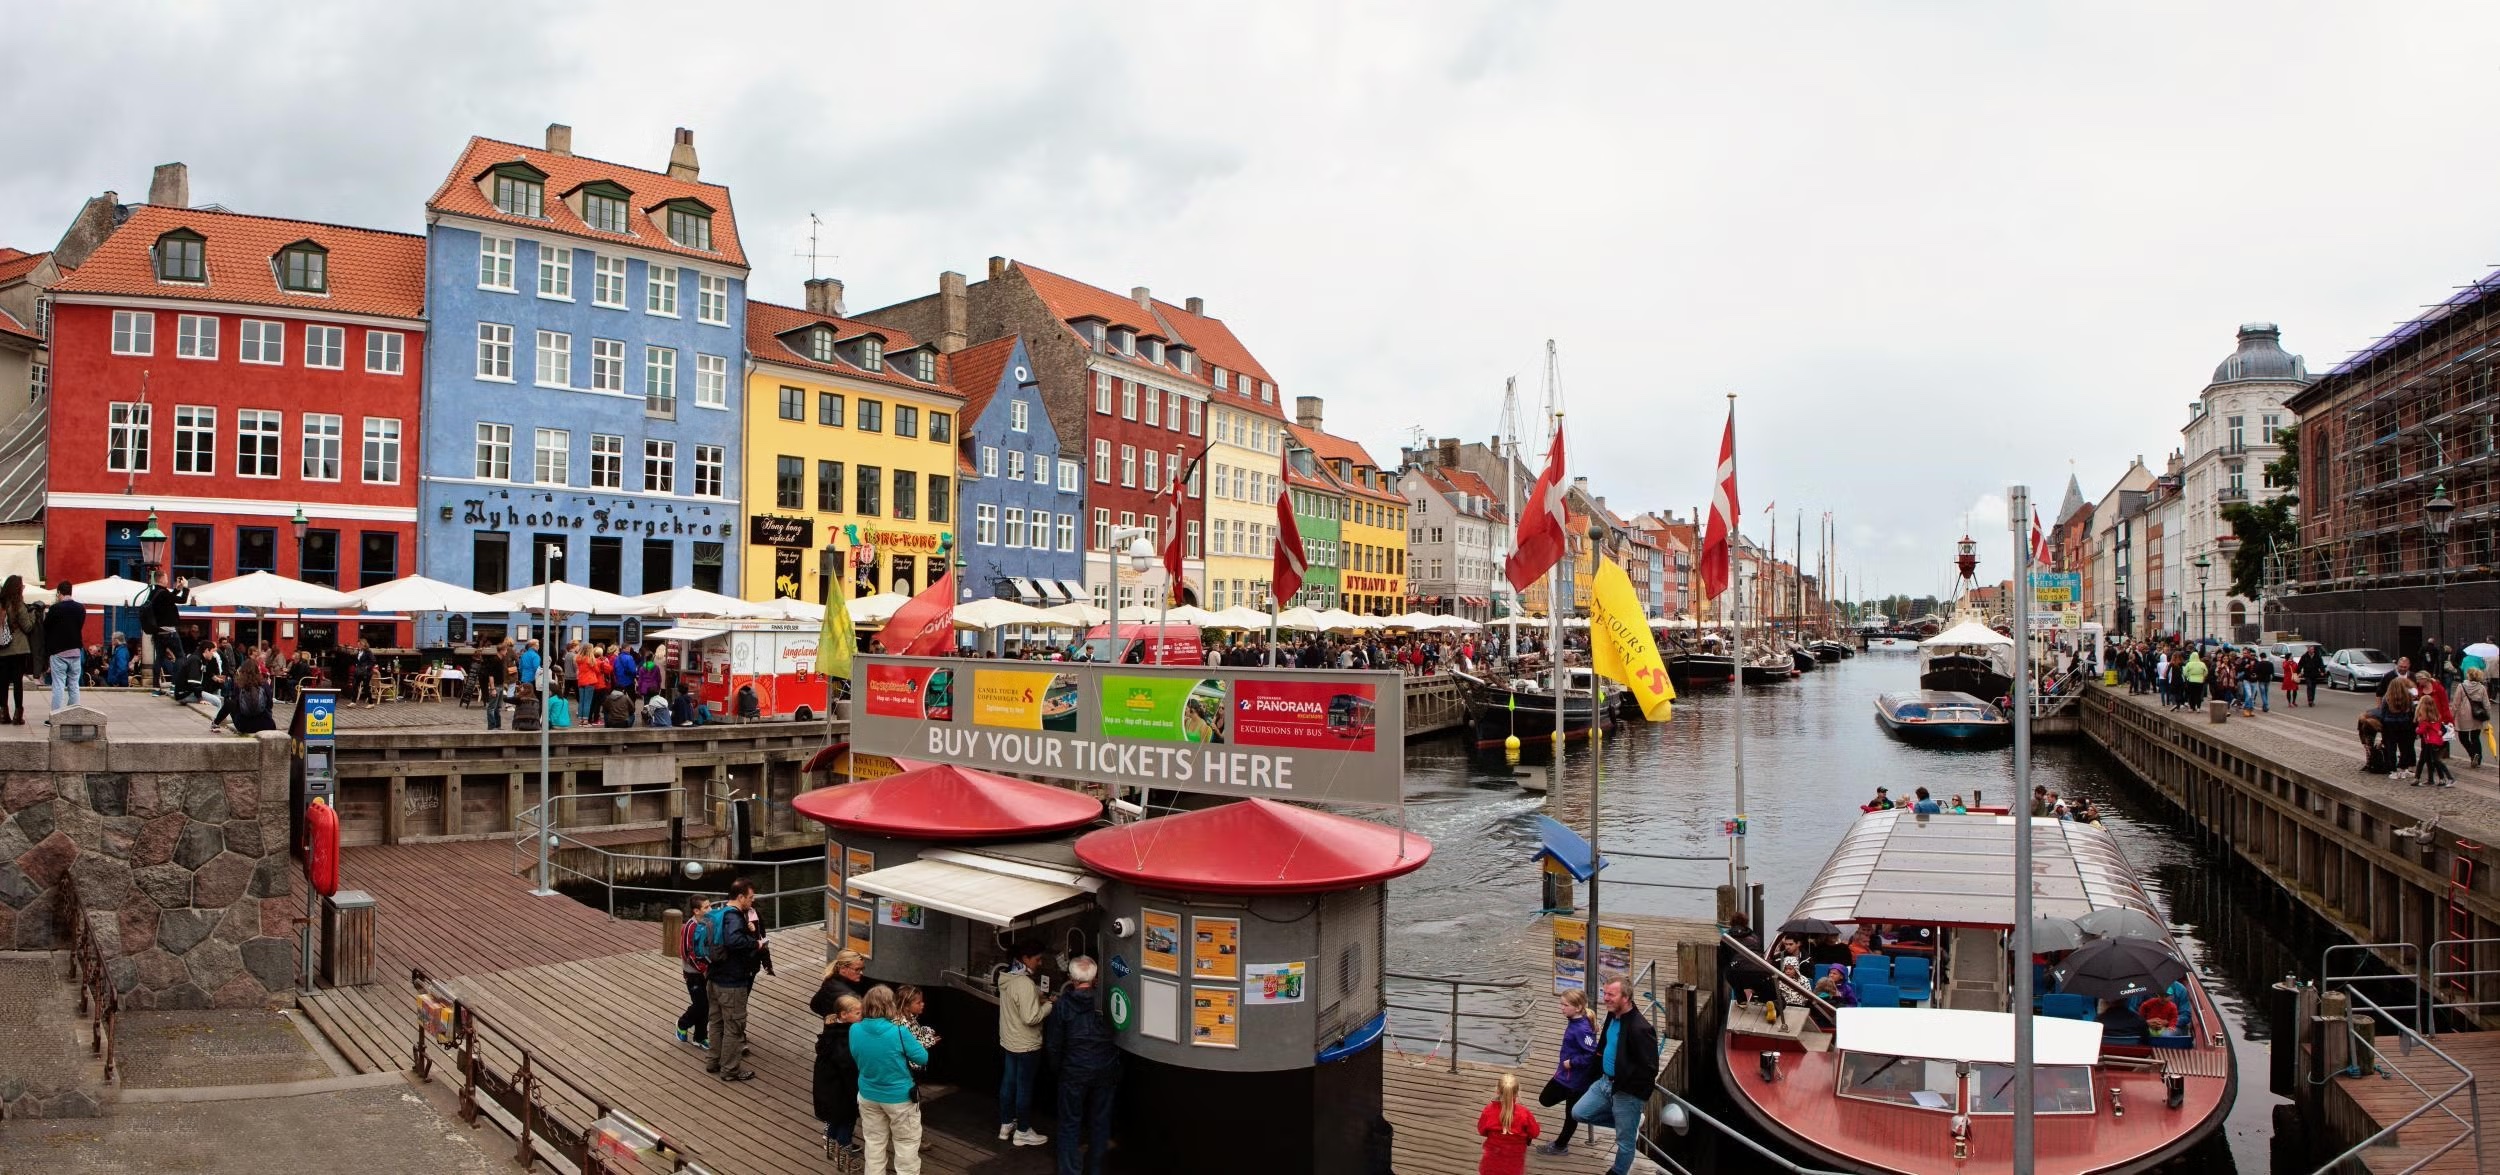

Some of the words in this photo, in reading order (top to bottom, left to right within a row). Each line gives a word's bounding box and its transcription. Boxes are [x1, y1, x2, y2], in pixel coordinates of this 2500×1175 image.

[464, 499, 585, 530] Nyhavns
[593, 508, 713, 539] Færgekro
[121, 527, 131, 540] 3
[828, 526, 839, 544] 7
[1348, 576, 1386, 592] NYHAVN
[1606, 613, 1646, 654] TOURS
[1256, 700, 1323, 713] PANORAMA
[1240, 724, 1291, 735] EXCURSIONS
[1294, 728, 1304, 736] BY
[1306, 728, 1322, 737] BUS
[853, 756, 872, 766] ANAL
[928, 727, 979, 758] BUY
[987, 733, 1063, 768] YOUR
[1070, 739, 1193, 781] TICKETS
[1204, 751, 1293, 790] HERE
